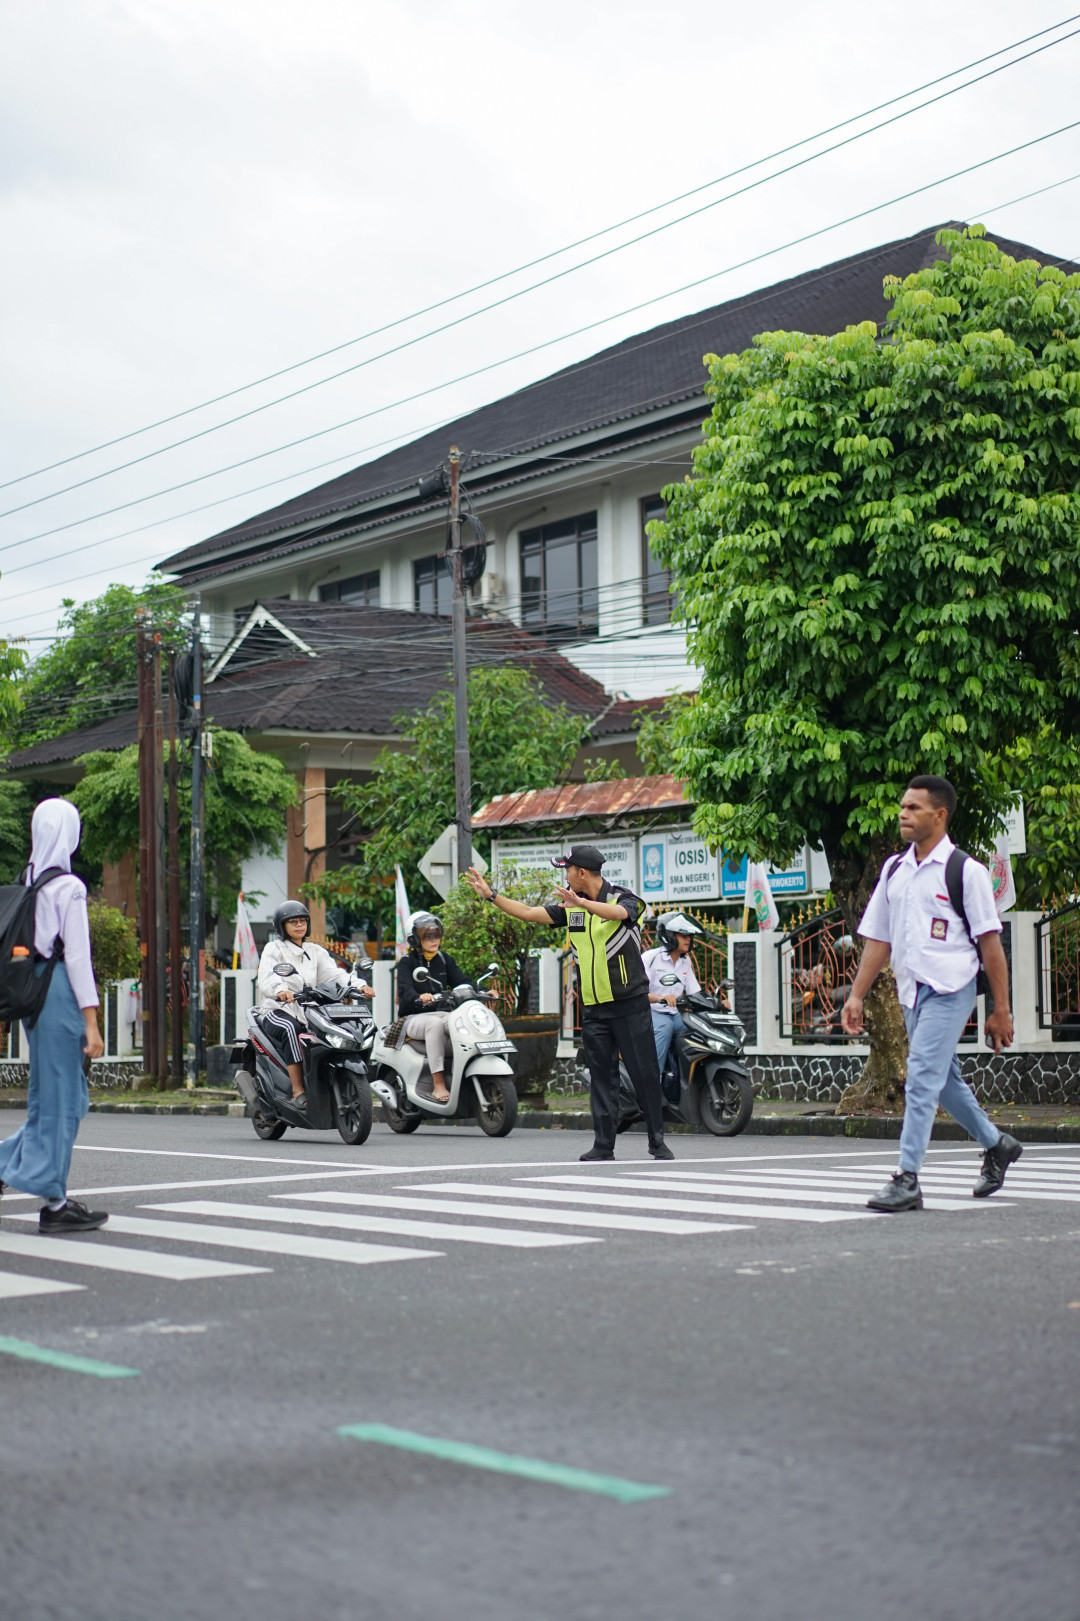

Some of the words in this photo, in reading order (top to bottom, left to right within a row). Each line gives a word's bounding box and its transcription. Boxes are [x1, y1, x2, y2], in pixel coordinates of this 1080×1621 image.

[602, 851, 628, 862] ORPRI)
[674, 848, 708, 868] (OSIS)
[669, 875, 683, 885] SMA
[685, 873, 710, 883] NEGERI
[711, 872, 715, 881] 1
[768, 875, 804, 887] URWOKERTO
[673, 884, 711, 895] PURWOKERTO
[724, 881, 737, 891] SMA
